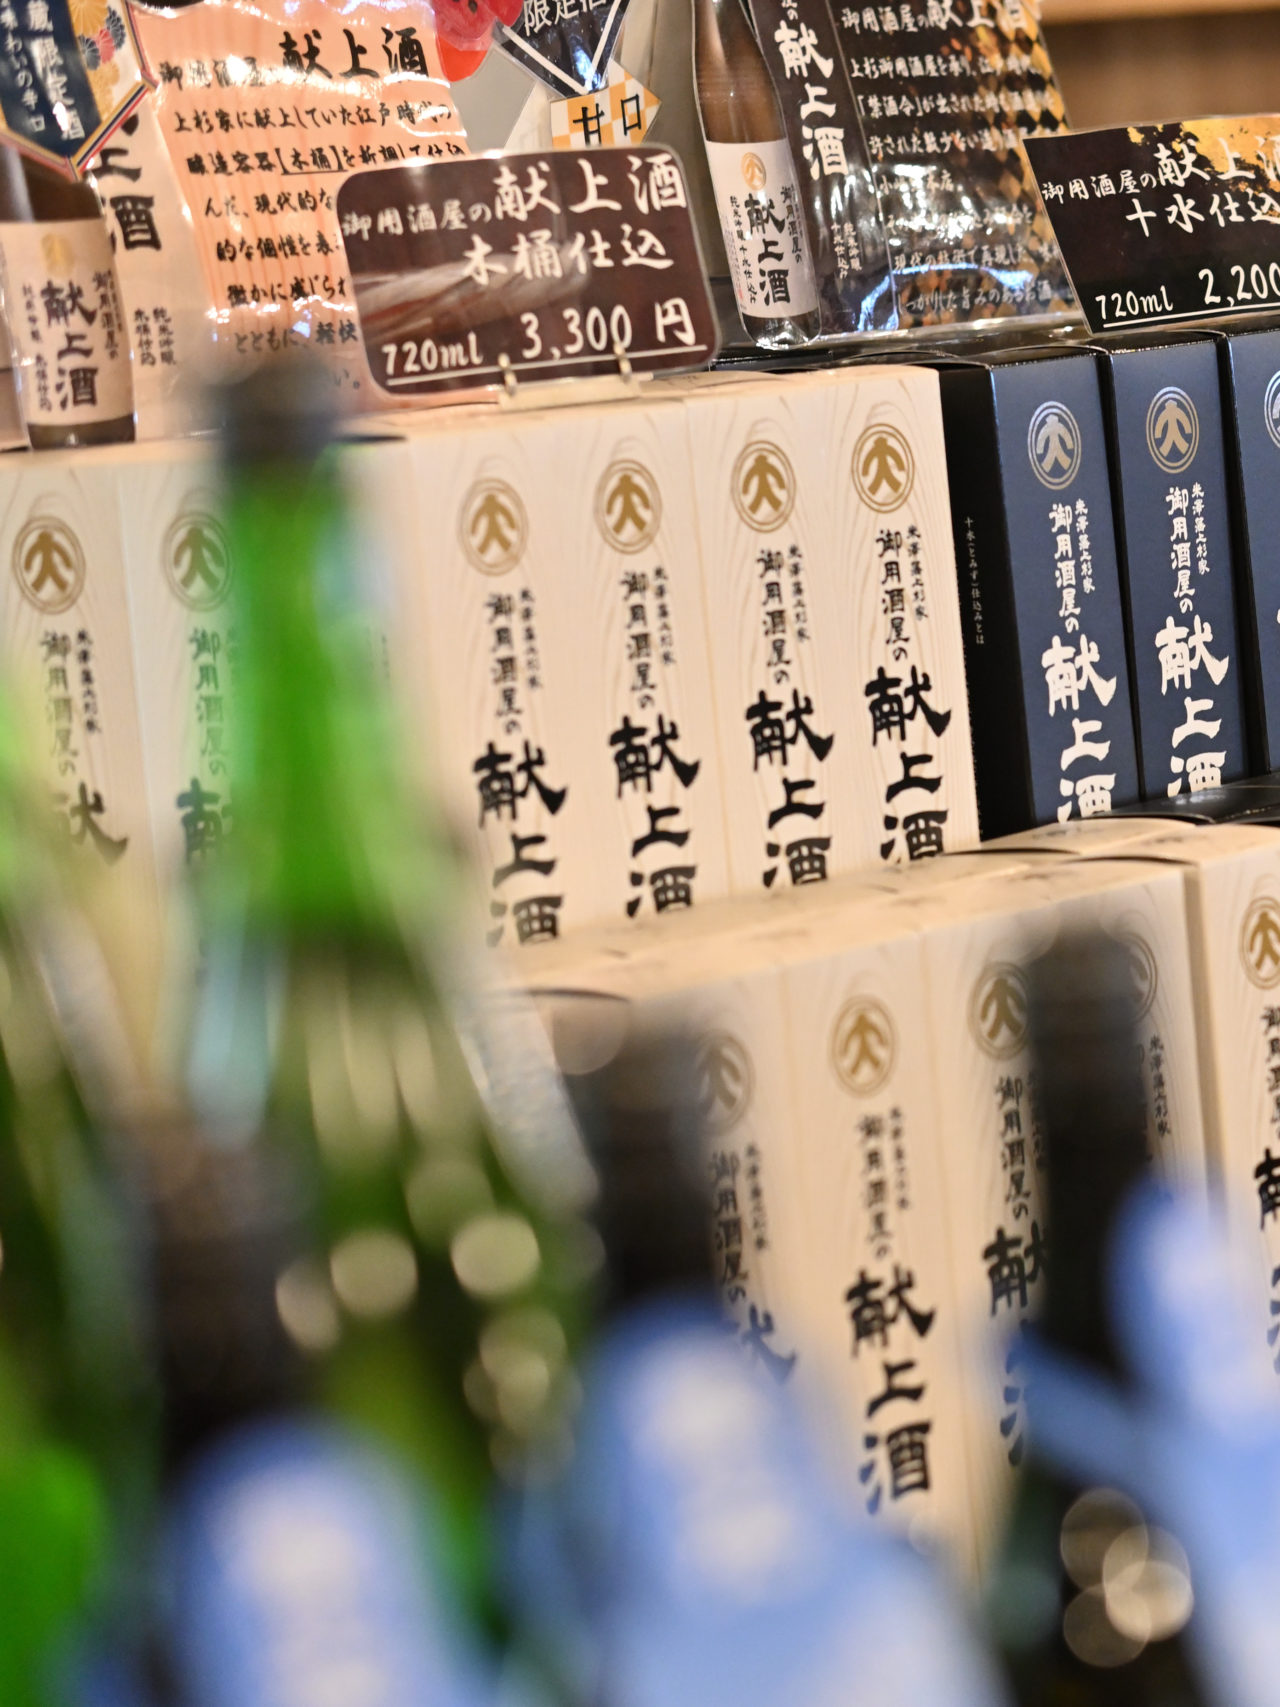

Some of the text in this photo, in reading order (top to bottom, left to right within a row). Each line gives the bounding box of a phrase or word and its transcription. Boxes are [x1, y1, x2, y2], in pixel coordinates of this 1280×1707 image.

[573, 94, 641, 146] 甘口
[774, 20, 849, 180] 献上酒
[216, 230, 341, 262] 的な個性を表
[341, 154, 687, 241] 御用酒屋の献上酒
[461, 223, 675, 286] 木桶仕込
[744, 193, 790, 306] 献上酒
[40, 280, 99, 411] 献上酒
[381, 332, 483, 376] 720ml
[520, 304, 633, 361] 3,300
[1095, 285, 1174, 320] 720ml
[875, 528, 911, 662] 御用酒屋の
[1048, 502, 1080, 634] 御用酒屋の
[1165, 487, 1195, 614] 御用酒屋の
[756, 548, 792, 684] 御用酒屋の
[844, 1262, 937, 1515] 献上酒
